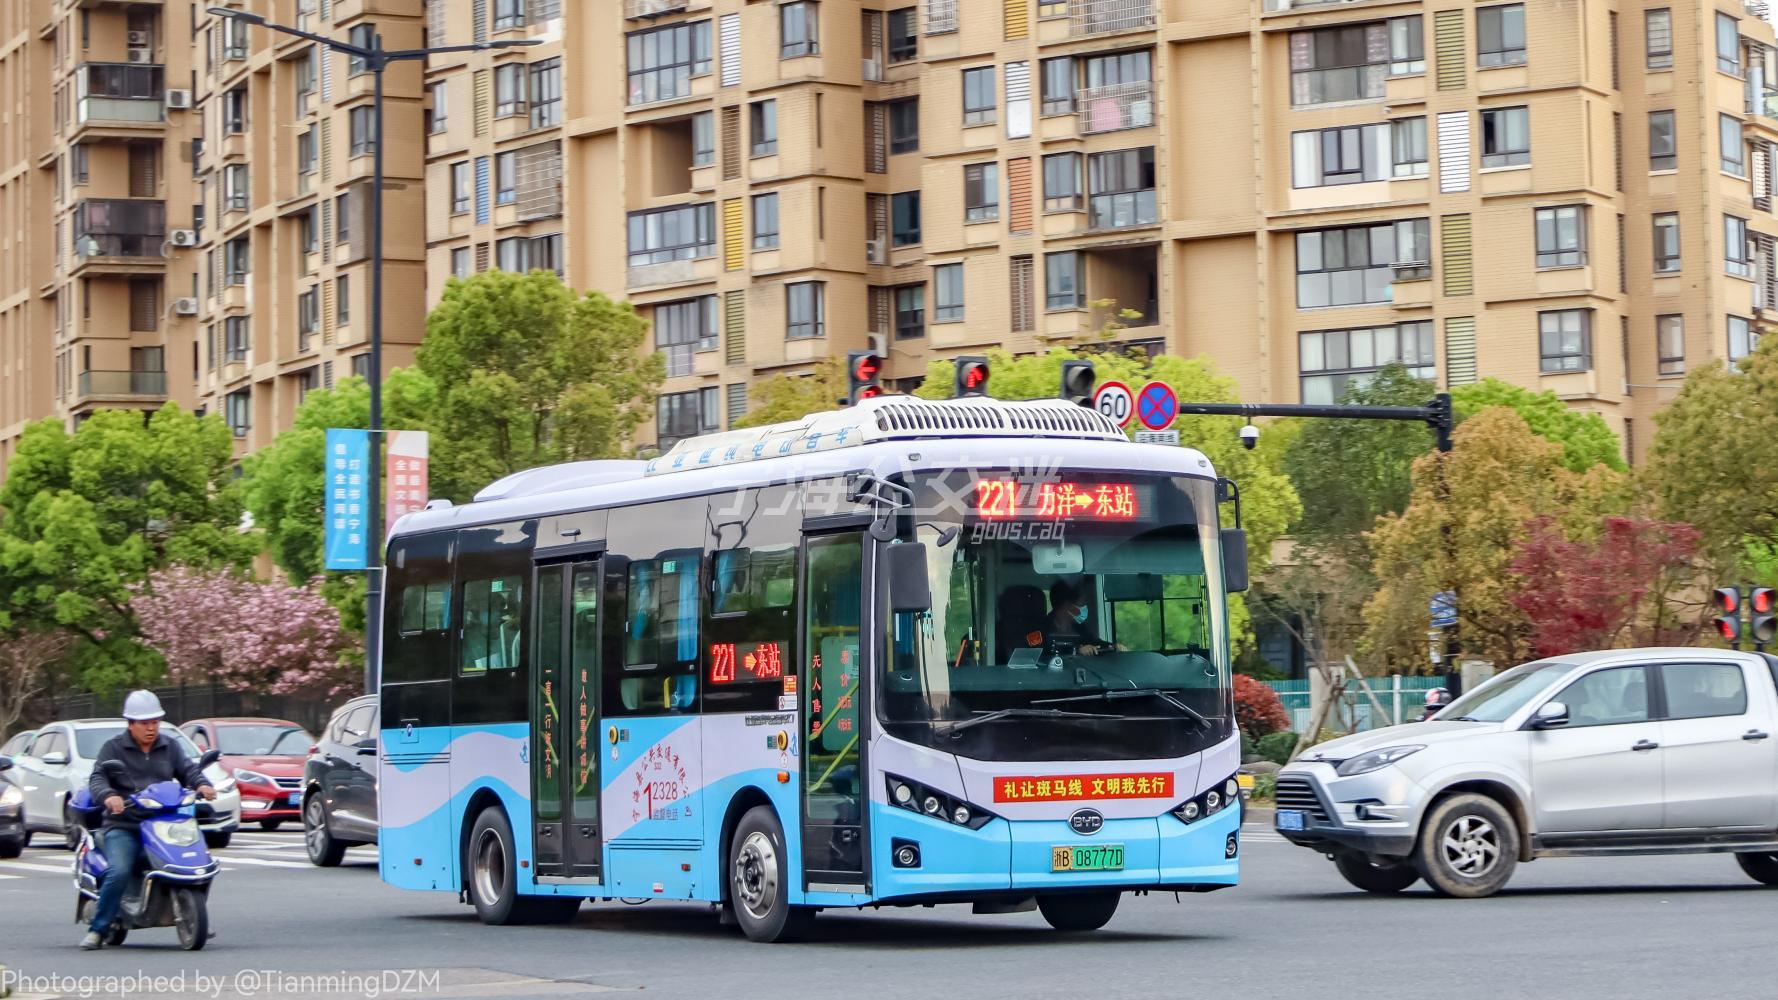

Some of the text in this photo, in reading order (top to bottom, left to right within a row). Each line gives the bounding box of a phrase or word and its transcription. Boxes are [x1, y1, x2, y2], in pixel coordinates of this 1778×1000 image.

[1101, 393, 1126, 418] 60
[977, 480, 1134, 517] 221 力洋 东站
[710, 643, 782, 682] 221 东站
[812, 654, 822, 735] 无人售票
[644, 781, 679, 820] 12328
[1004, 776, 1166, 799] 礼让斑马线 文明我先行
[1073, 816, 1101, 828] BYD
[1053, 849, 1123, 868] 浙B 08777D
